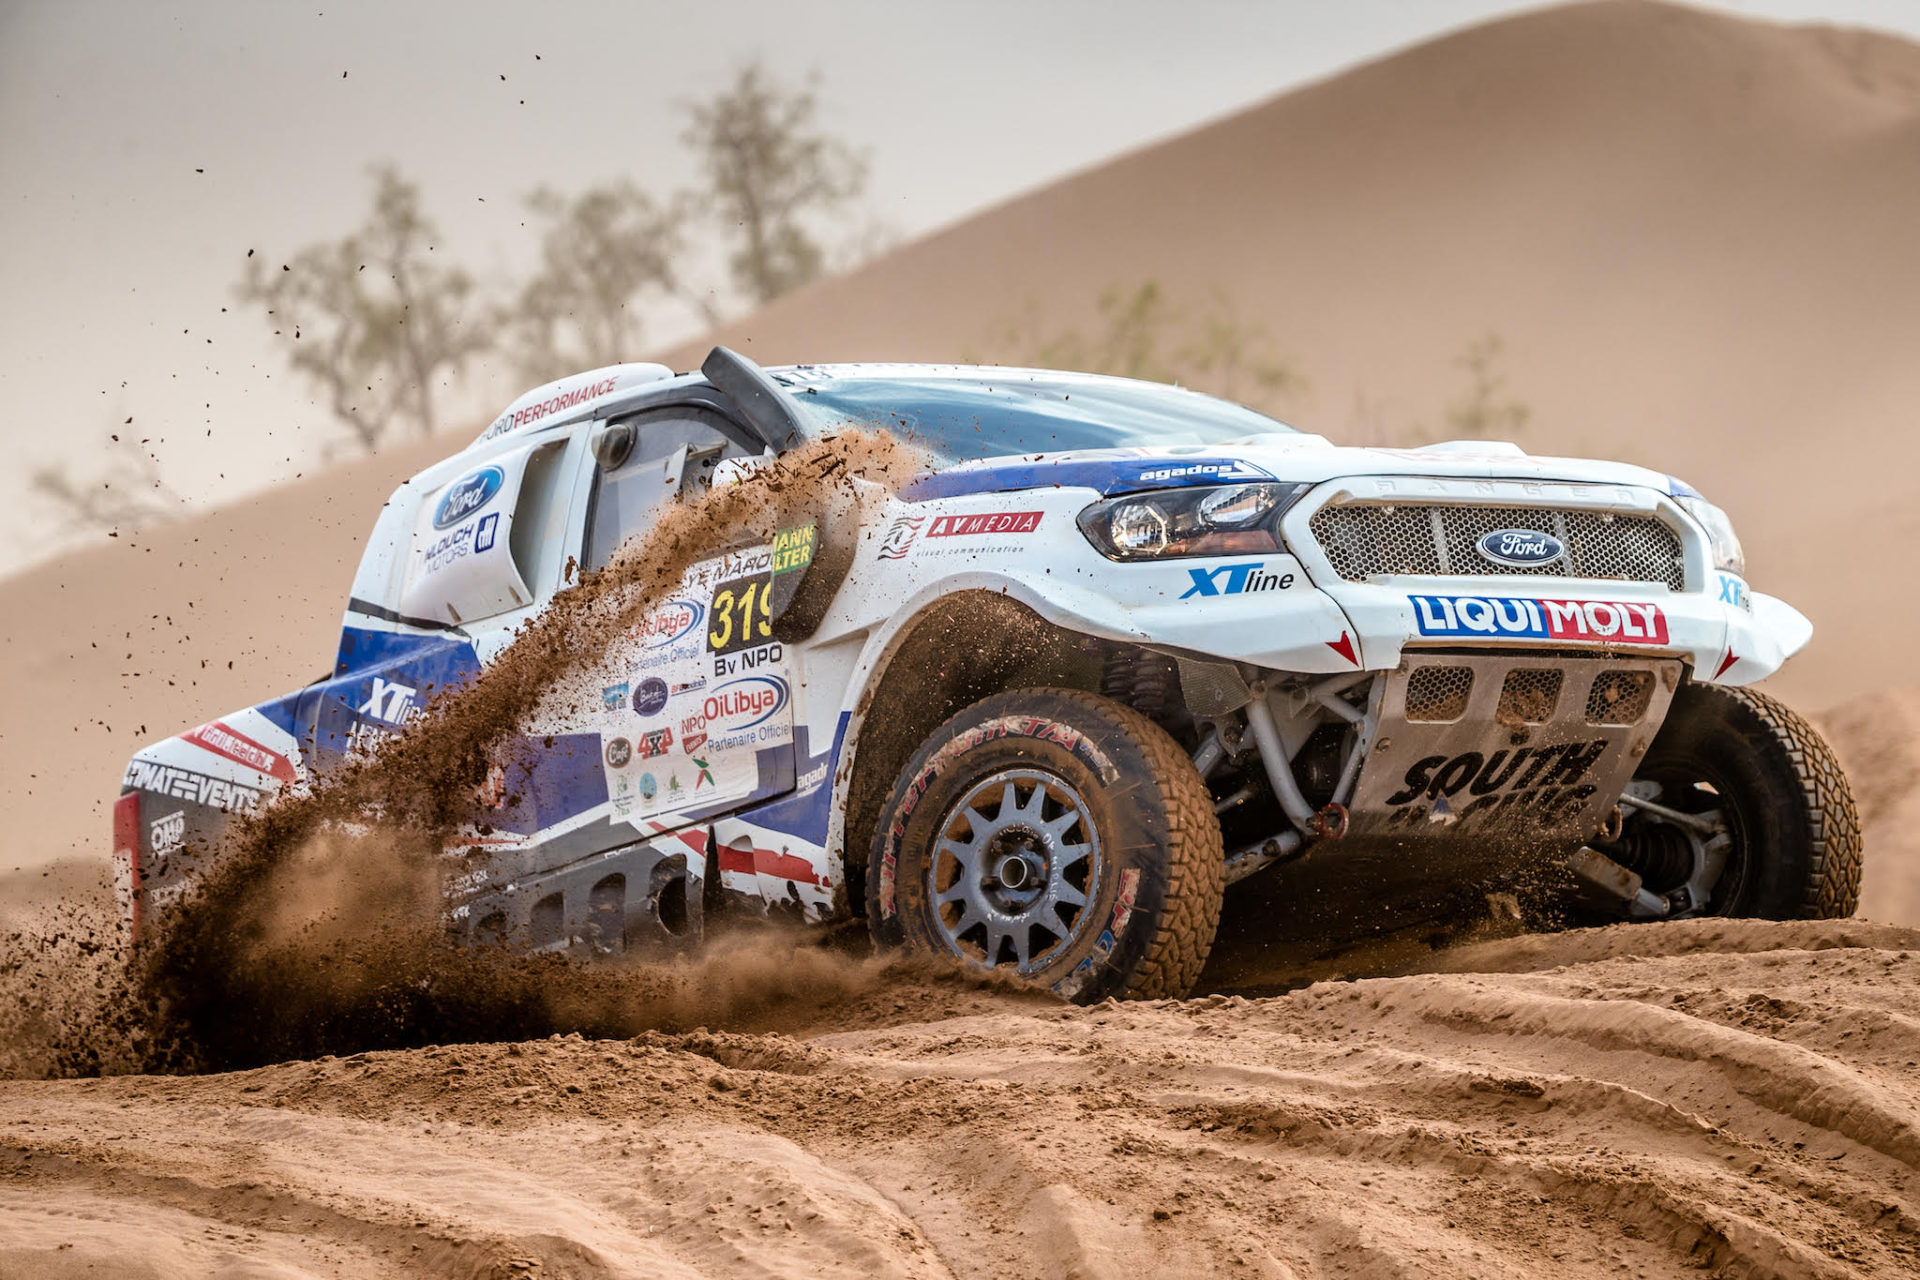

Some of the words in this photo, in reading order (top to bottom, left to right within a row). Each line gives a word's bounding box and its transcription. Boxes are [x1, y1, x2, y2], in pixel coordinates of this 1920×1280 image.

[1140, 465, 1233, 480] agados
[442, 474, 488, 523] Ford
[1501, 532, 1548, 555] Ford
[1178, 562, 1295, 600] XTline
[1415, 597, 1544, 633] LIQUI
[1541, 600, 1657, 640] MOLY
[741, 645, 783, 671] NPO
[704, 689, 774, 721] OiLibya
[681, 715, 706, 735] NPO
[707, 731, 757, 754] Partenaire
[759, 719, 793, 742] Officiel
[1385, 740, 1609, 805] SOUTH
